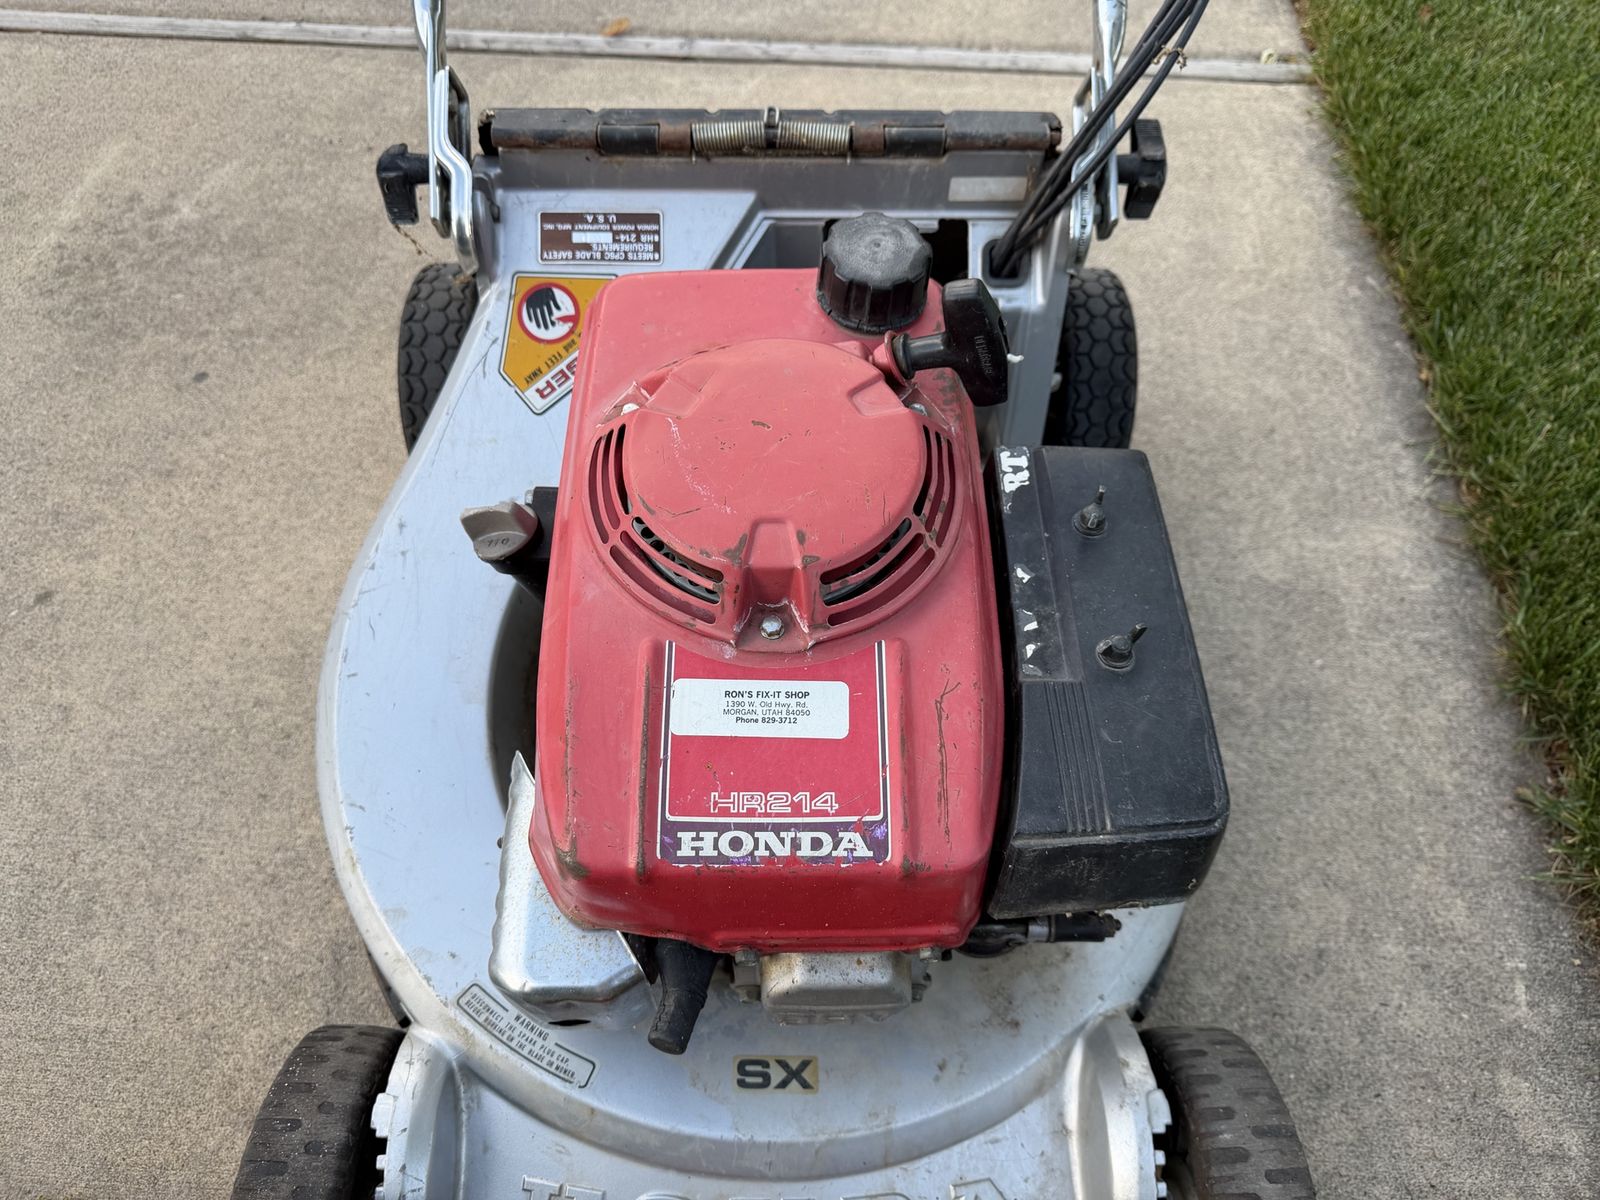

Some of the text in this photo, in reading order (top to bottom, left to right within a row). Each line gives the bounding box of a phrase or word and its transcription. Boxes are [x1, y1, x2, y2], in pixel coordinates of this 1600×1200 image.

[640, 234, 653, 242] HR
[543, 251, 653, 260] MEETS CPSC BLADE SAFETY
[591, 243, 654, 251] REQUIREMENTS.
[544, 352, 562, 369] FEET
[524, 367, 543, 385] AWAY
[785, 691, 810, 699] SHOP
[723, 708, 758, 716] MORGAN,
[762, 708, 783, 716] UTAH
[726, 700, 746, 708] 1390
[774, 701, 793, 709] Hwy.
[710, 792, 838, 813] HR214
[676, 830, 873, 857] HONDA
[471, 992, 504, 1023] DISCONNECT
[505, 1022, 517, 1036] THE
[518, 1030, 537, 1047] SPARK
[539, 1042, 556, 1058] PLUG
[514, 1012, 550, 1042] WARNING
[464, 1000, 485, 1022] BEFORE
[483, 1018, 506, 1040] WORKING
[506, 1034, 514, 1044] ON
[515, 1040, 526, 1051] THE
[528, 1049, 545, 1064] BLADE
[546, 1059, 554, 1068] OR
[736, 1058, 814, 1090] SX
